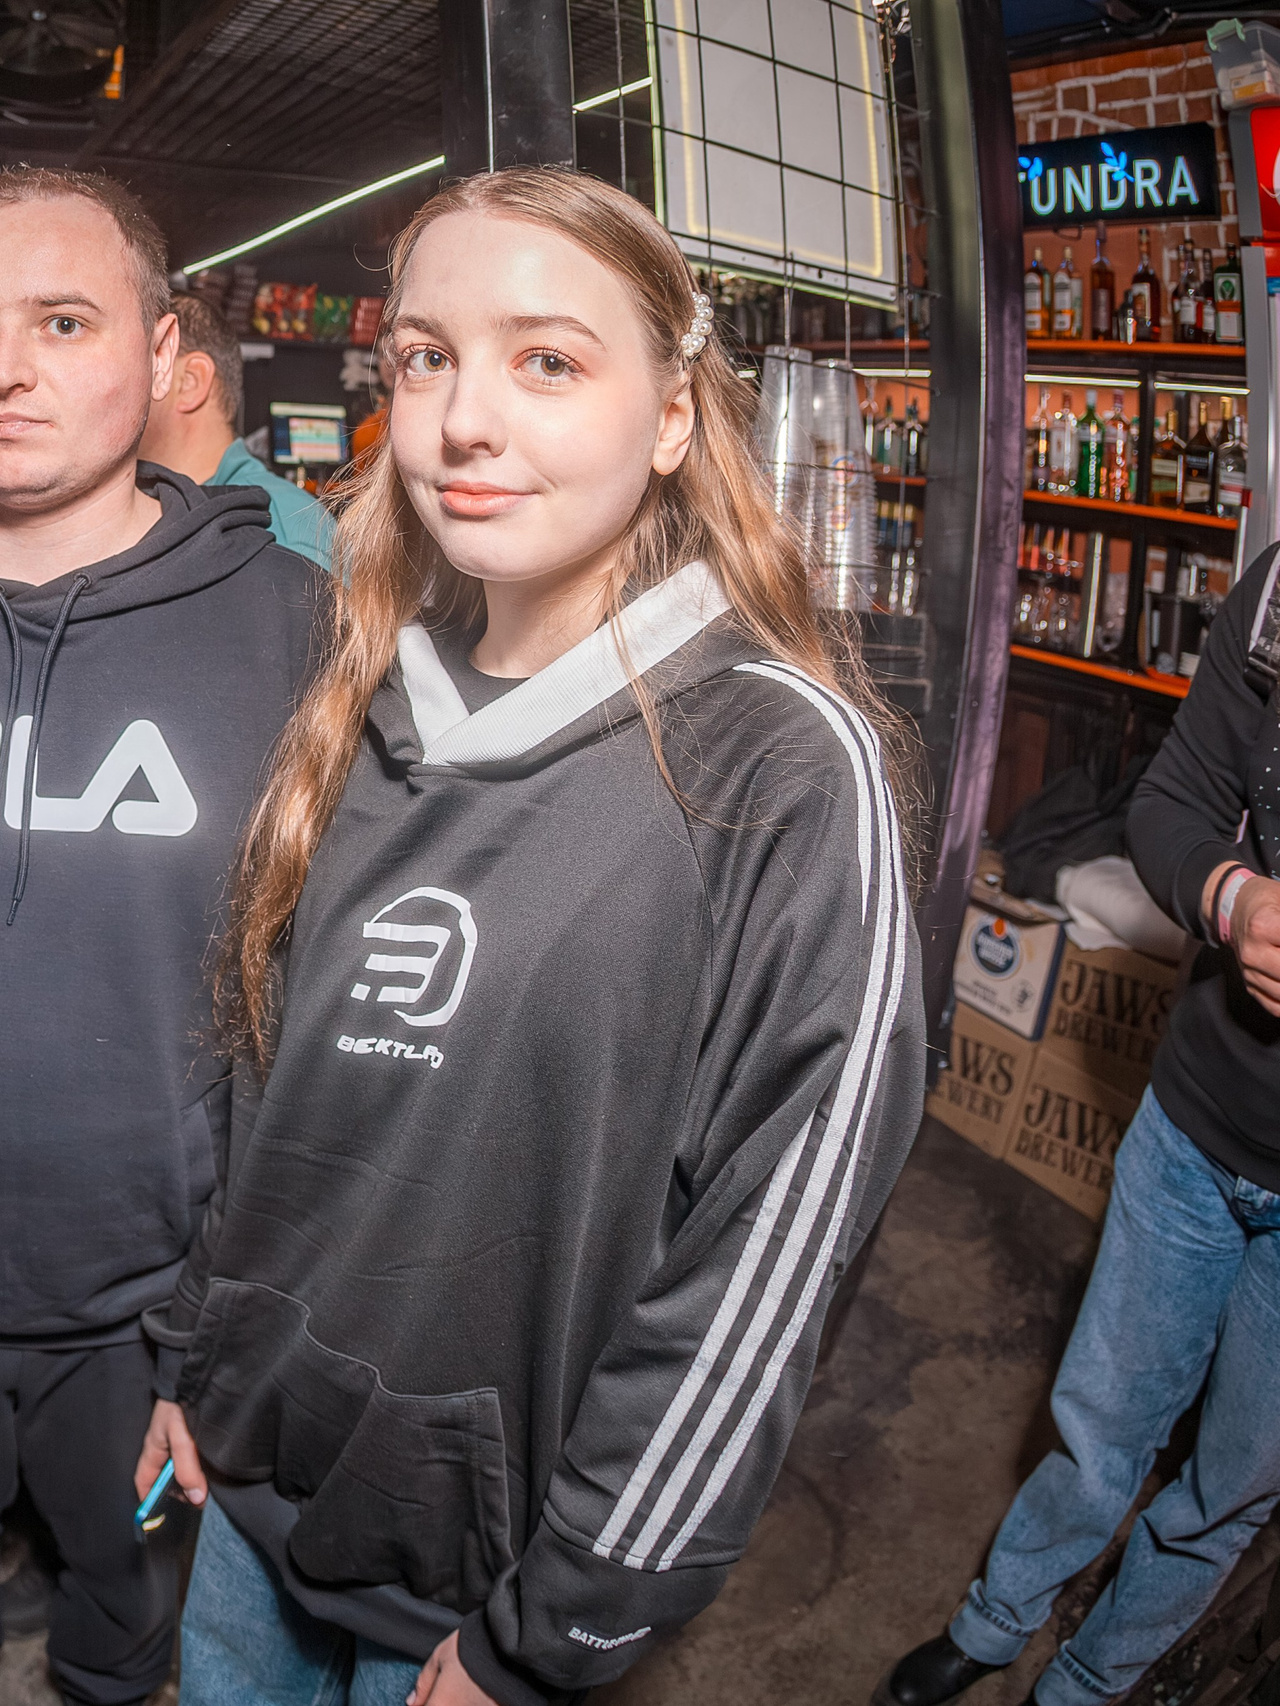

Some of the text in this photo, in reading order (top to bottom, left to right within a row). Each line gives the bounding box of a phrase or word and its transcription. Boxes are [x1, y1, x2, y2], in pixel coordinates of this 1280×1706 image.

[1018, 155, 1199, 215] UNDRA
[956, 1036, 1017, 1096] WS
[1025, 1082, 1122, 1156] JAW
